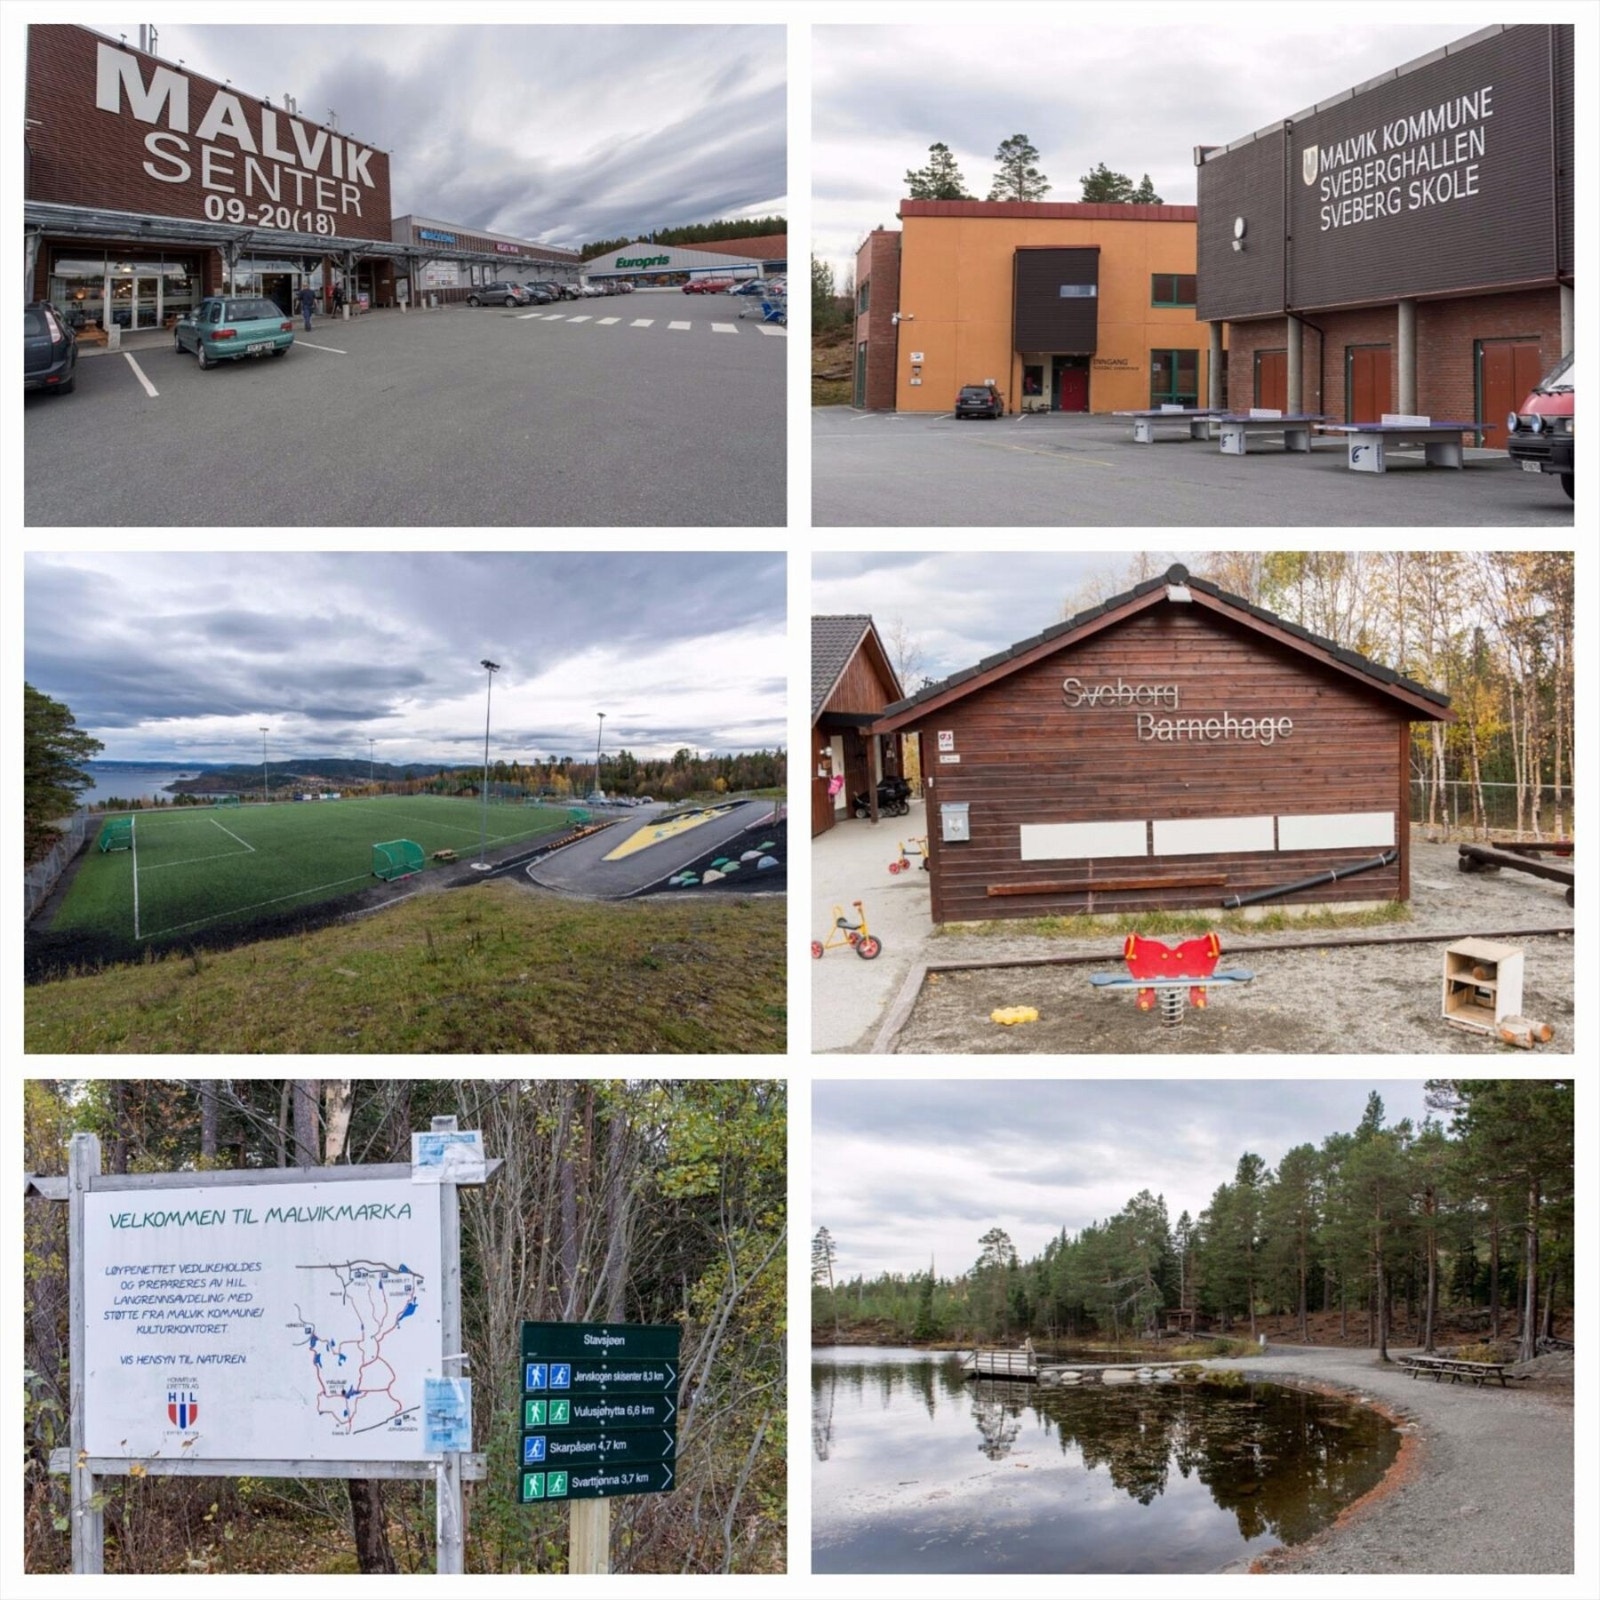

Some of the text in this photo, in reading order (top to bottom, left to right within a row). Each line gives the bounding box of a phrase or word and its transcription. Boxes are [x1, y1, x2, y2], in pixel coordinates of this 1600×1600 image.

[96, 41, 376, 188] MALVIK
[1320, 86, 1493, 172] MALVIK KOMMUNE
[1320, 126, 1485, 201] SVEBERGHALLEN
[143, 132, 362, 217] SENTER
[1320, 164, 1479, 231] SVEBERG SKOLE
[204, 195, 336, 236] 09-20(18)
[615, 254, 670, 269] Europris
[1062, 677, 1179, 712] Sveberg
[1137, 711, 1293, 746] Barnehage
[109, 1203, 412, 1229] VELKOMMEN TIL MALVIKMARKA
[105, 1262, 262, 1276] LØYPENETTET VEDLIKEHOLDES
[120, 1281, 134, 1290] OG
[138, 1279, 207, 1289] PREPARERES
[208, 1278, 223, 1288] AV
[113, 1293, 253, 1305] LANGRENNSAVDELING MED
[103, 1310, 139, 1321] STØTTE
[141, 1310, 164, 1319] FRA
[166, 1309, 204, 1320] MALVIK
[583, 1333, 626, 1347] Stavsjøen
[120, 1356, 134, 1365] VIS
[136, 1355, 176, 1365] HENSYN
[178, 1355, 193, 1365] TIL
[574, 1371, 664, 1384] Jervskogen skisenter 8,3 km
[574, 1405, 655, 1419] Vulusjøhytta 6,6 km
[550, 1439, 627, 1454] Skarpåsen 4,7 km
[572, 1473, 649, 1489] Svarttjønna 3,7 km
